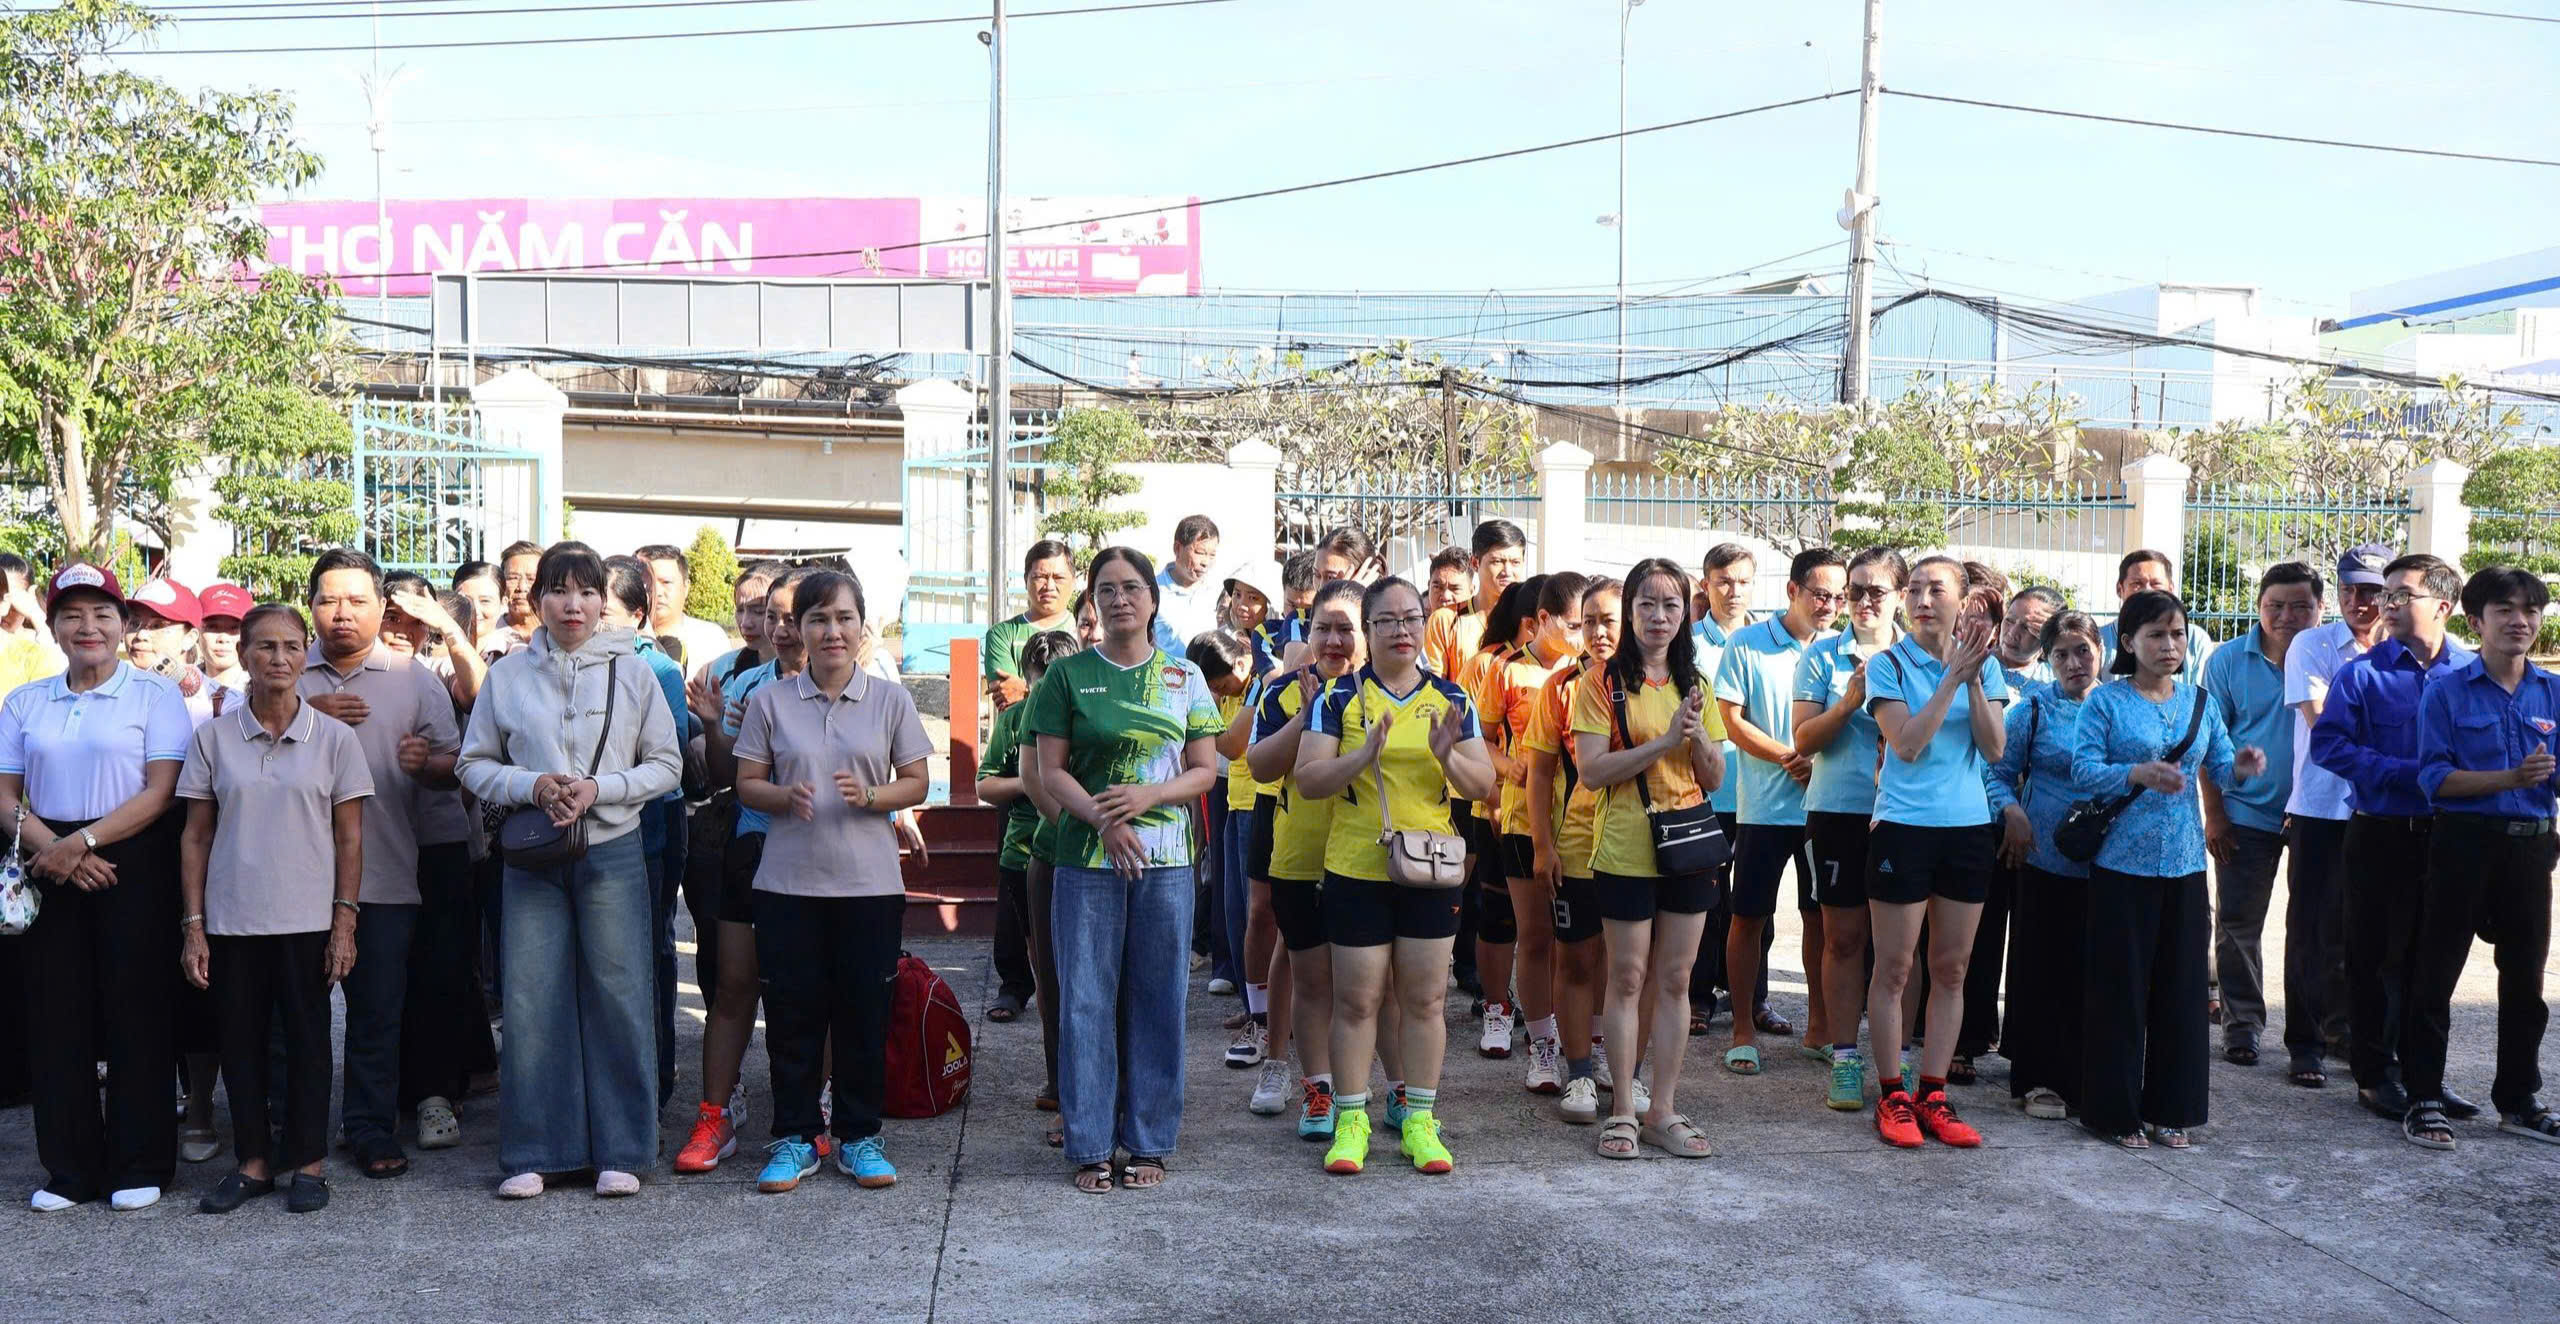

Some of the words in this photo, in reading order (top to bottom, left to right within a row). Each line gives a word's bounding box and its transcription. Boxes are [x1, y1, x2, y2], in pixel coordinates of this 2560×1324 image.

[412, 209, 585, 274] NĂM
[603, 208, 753, 273] CĂN
[947, 248, 1020, 268] HOE
[1024, 248, 1079, 268] WIFI
[1823, 860, 1840, 887] 7
[942, 1055, 969, 1077] JOOLA
